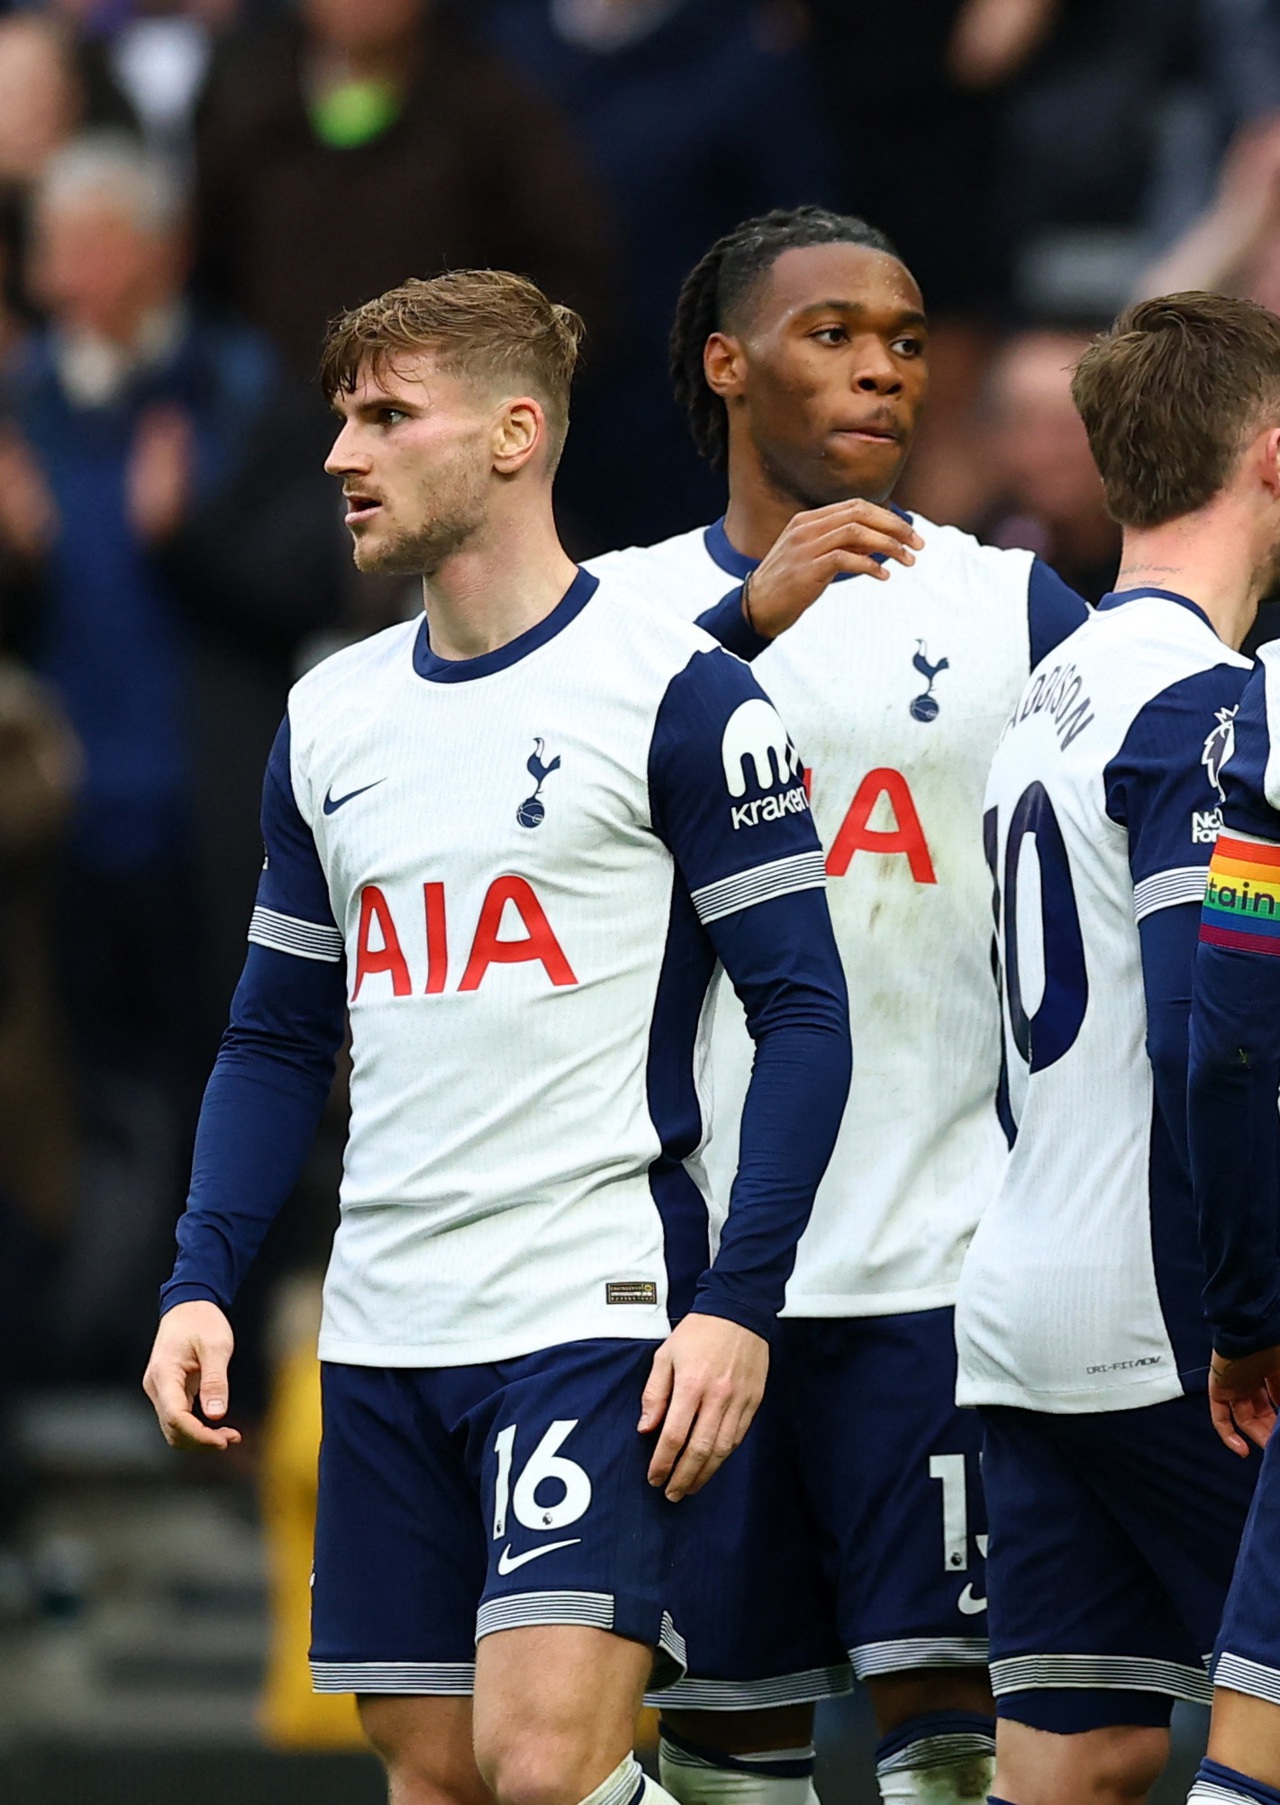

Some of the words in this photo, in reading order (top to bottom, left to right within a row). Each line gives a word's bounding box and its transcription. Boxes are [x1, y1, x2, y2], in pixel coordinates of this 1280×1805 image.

[998, 663, 1095, 753] ADDISON
[731, 786, 810, 830] kraken
[350, 875, 579, 1003] AIA
[1208, 878, 1275, 915] tain
[493, 1419, 592, 1541] 16
[929, 1454, 989, 1571] 1
